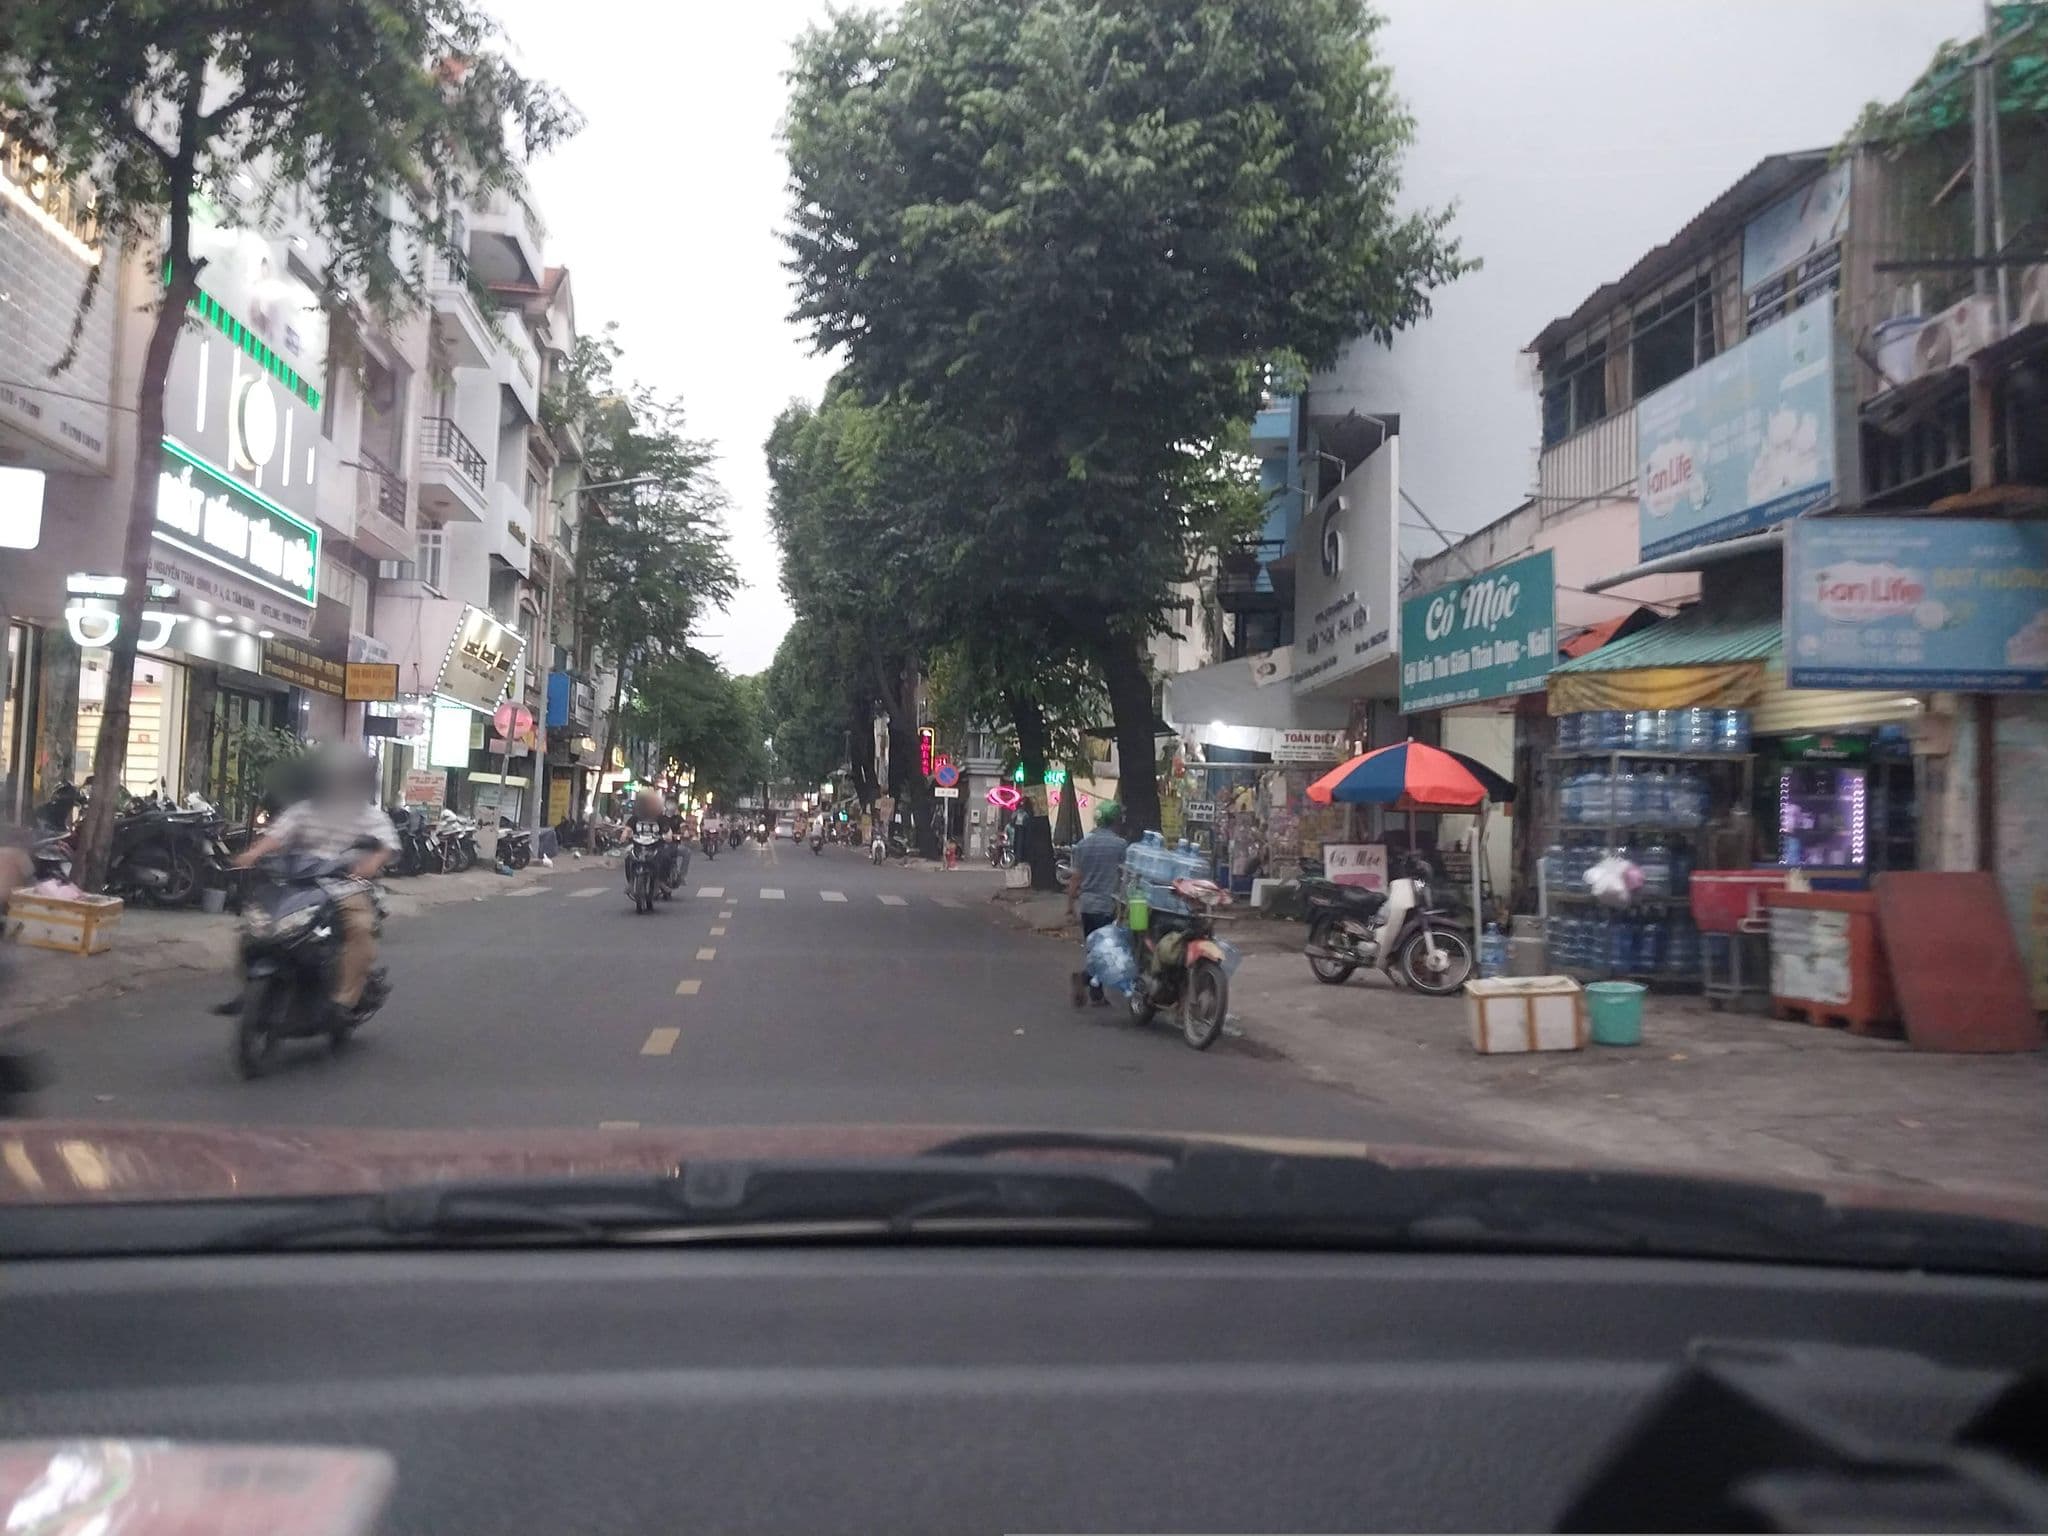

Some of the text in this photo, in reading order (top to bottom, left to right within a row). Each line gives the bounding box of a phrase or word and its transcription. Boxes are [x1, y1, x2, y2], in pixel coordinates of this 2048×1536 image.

[1669, 453, 1693, 485] Life
[1461, 575, 1520, 632] Mộc
[1284, 731, 1311, 743] TOÀN
